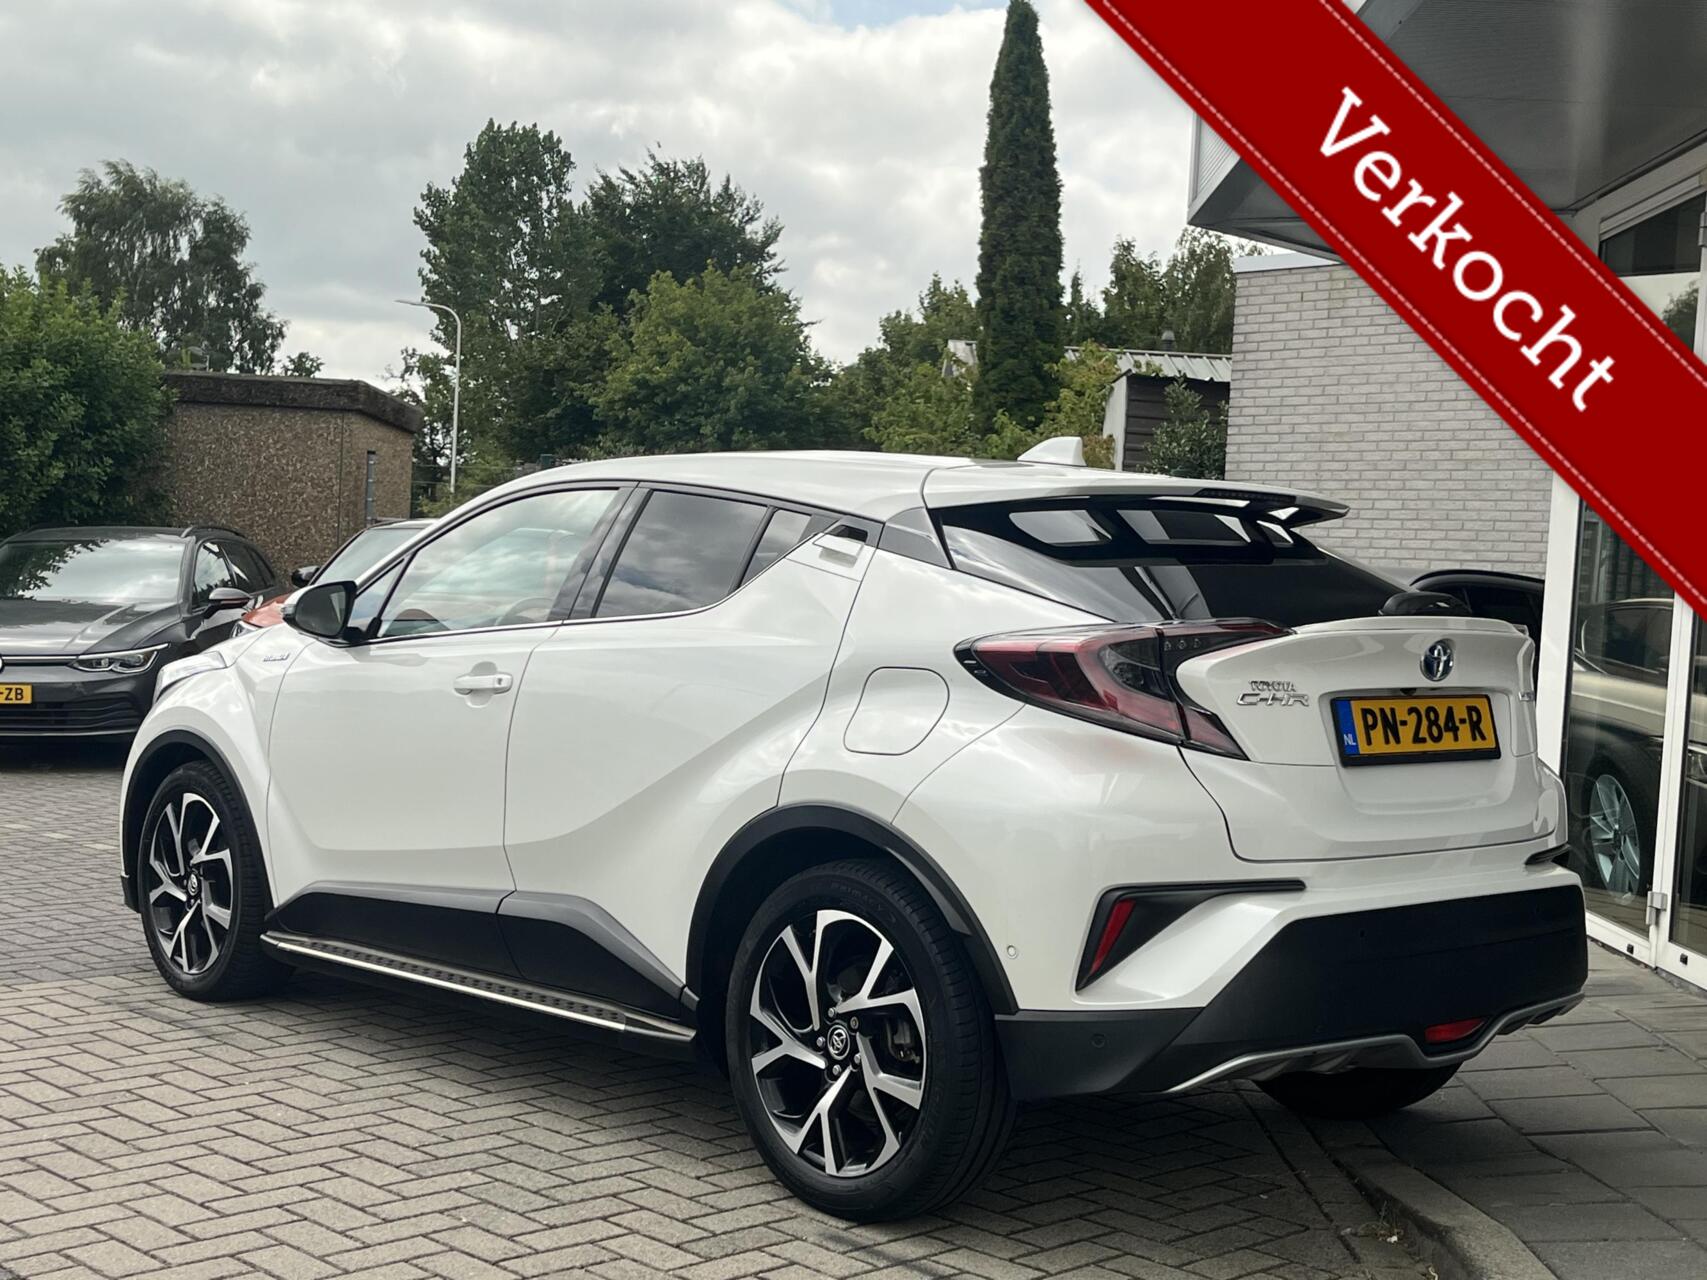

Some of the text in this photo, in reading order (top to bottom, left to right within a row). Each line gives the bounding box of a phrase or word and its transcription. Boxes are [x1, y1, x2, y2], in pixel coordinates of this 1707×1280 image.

[1249, 681, 1296, 692] TOYOTA
[1343, 705, 1487, 746] NL PN-284-R
